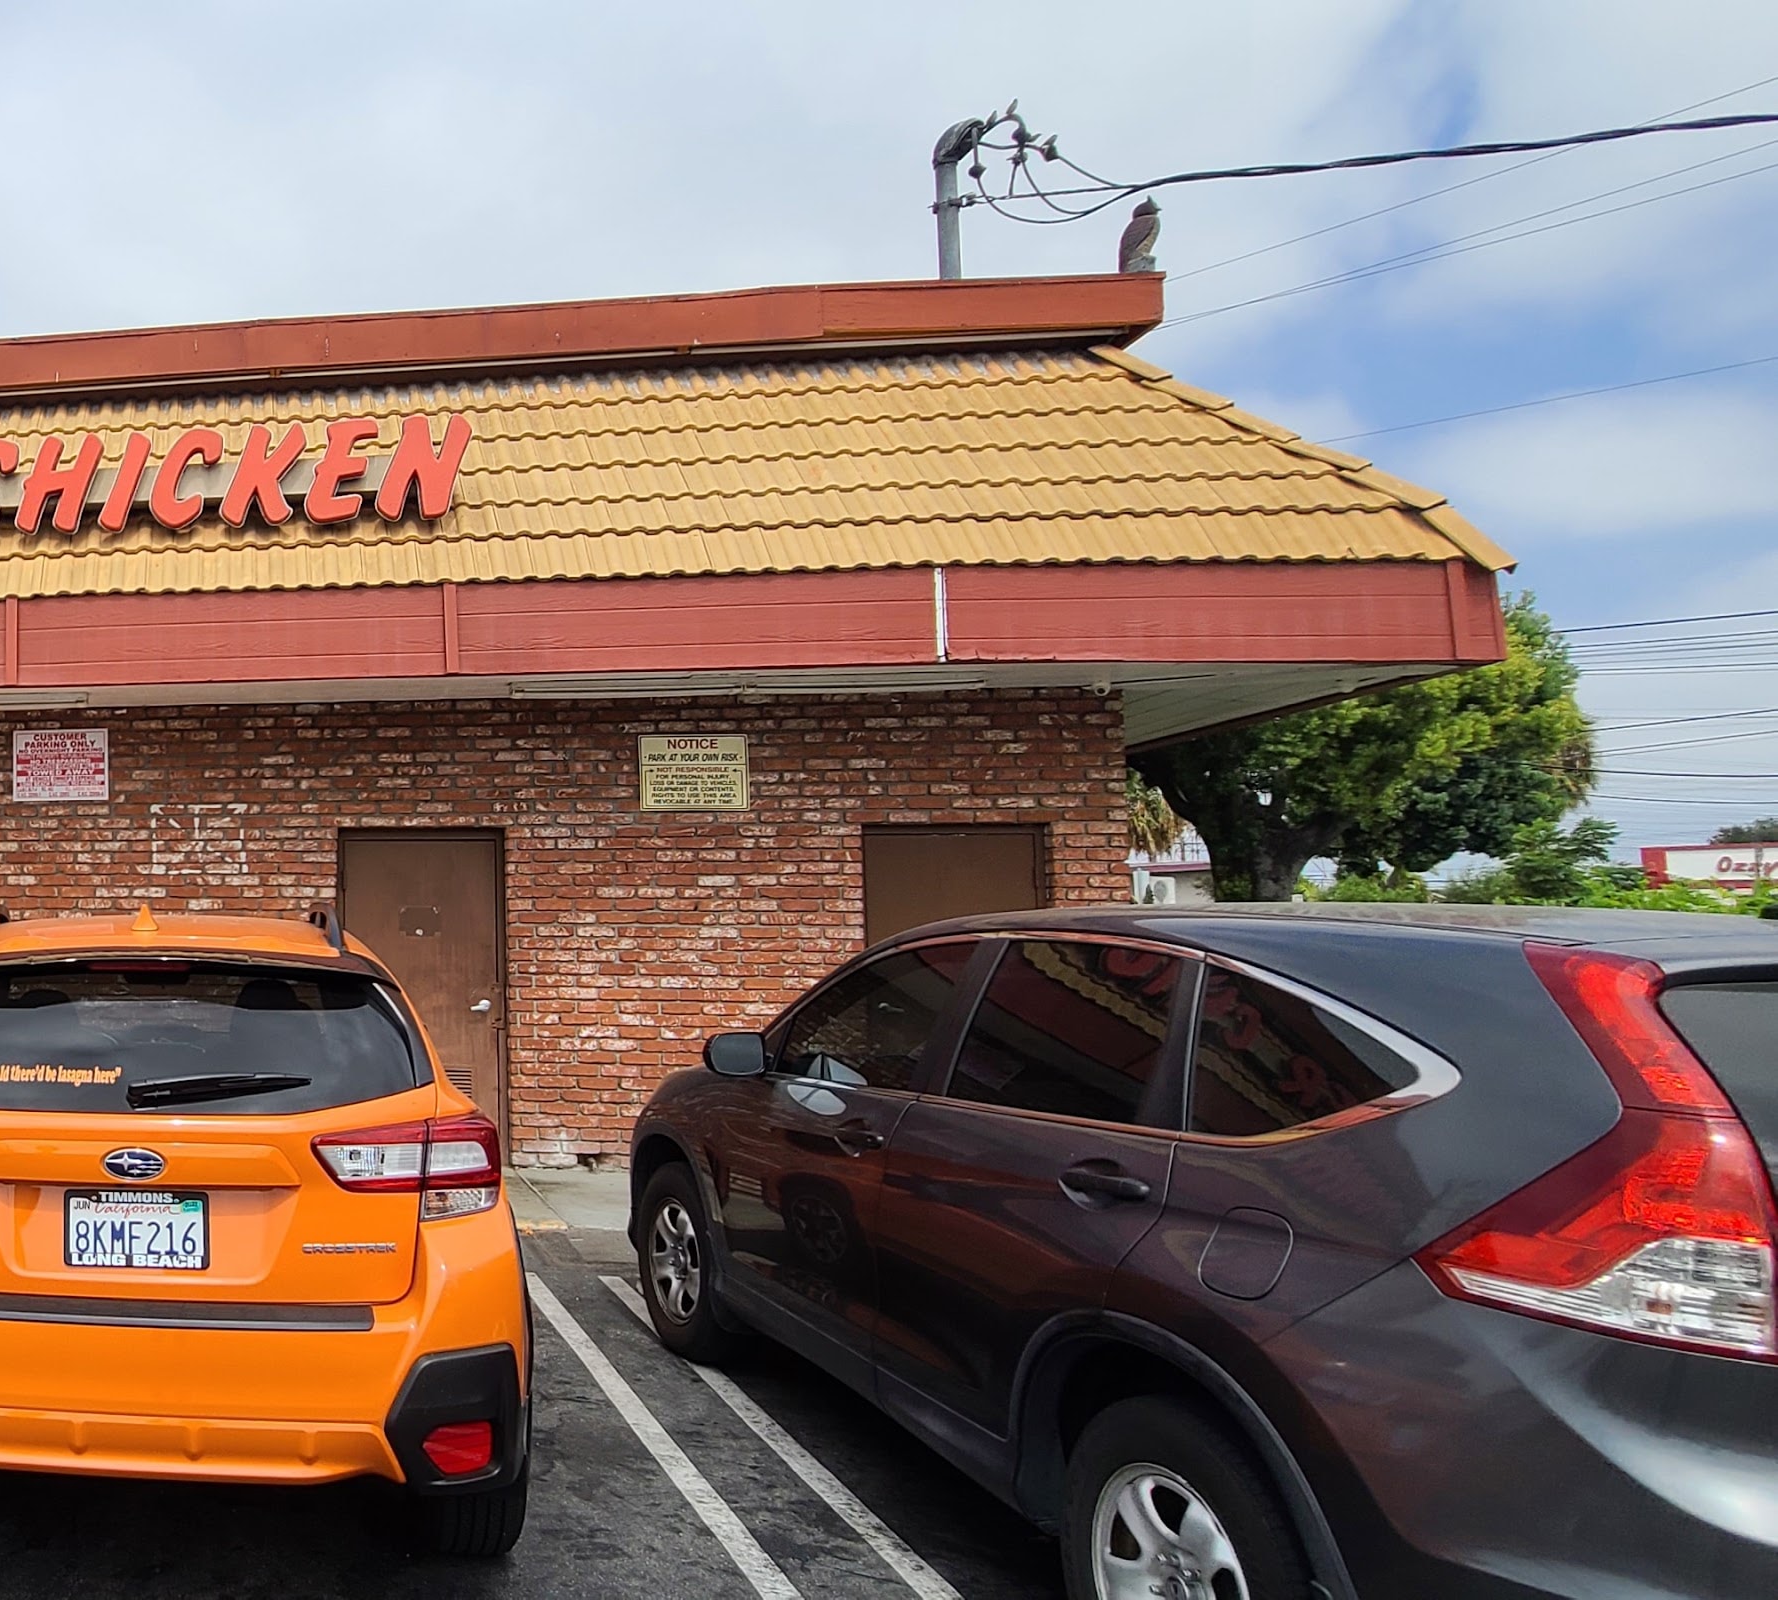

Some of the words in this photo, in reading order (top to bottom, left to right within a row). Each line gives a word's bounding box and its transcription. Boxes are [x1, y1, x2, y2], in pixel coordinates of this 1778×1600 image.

[33, 733, 87, 741] CUSTOMER
[70, 740, 96, 748] ONLY
[667, 739, 719, 749] NOTICE
[648, 753, 666, 762] PARK
[669, 753, 678, 761] AT
[680, 753, 700, 762] YOUR
[702, 753, 720, 762] OWN
[721, 753, 739, 761] RISK
[10, 1064, 44, 1082] there'd
[45, 1065, 56, 1082] be
[57, 1065, 92, 1087] lasagna
[98, 1191, 175, 1204] TIMMONS
[74, 1201, 90, 1210] JUN
[94, 1203, 181, 1219] California
[75, 1220, 197, 1256] 8KMF216
[302, 1242, 397, 1254] CROSSTREK
[71, 1253, 127, 1266] LONG
[132, 1254, 203, 1268] BEACH
